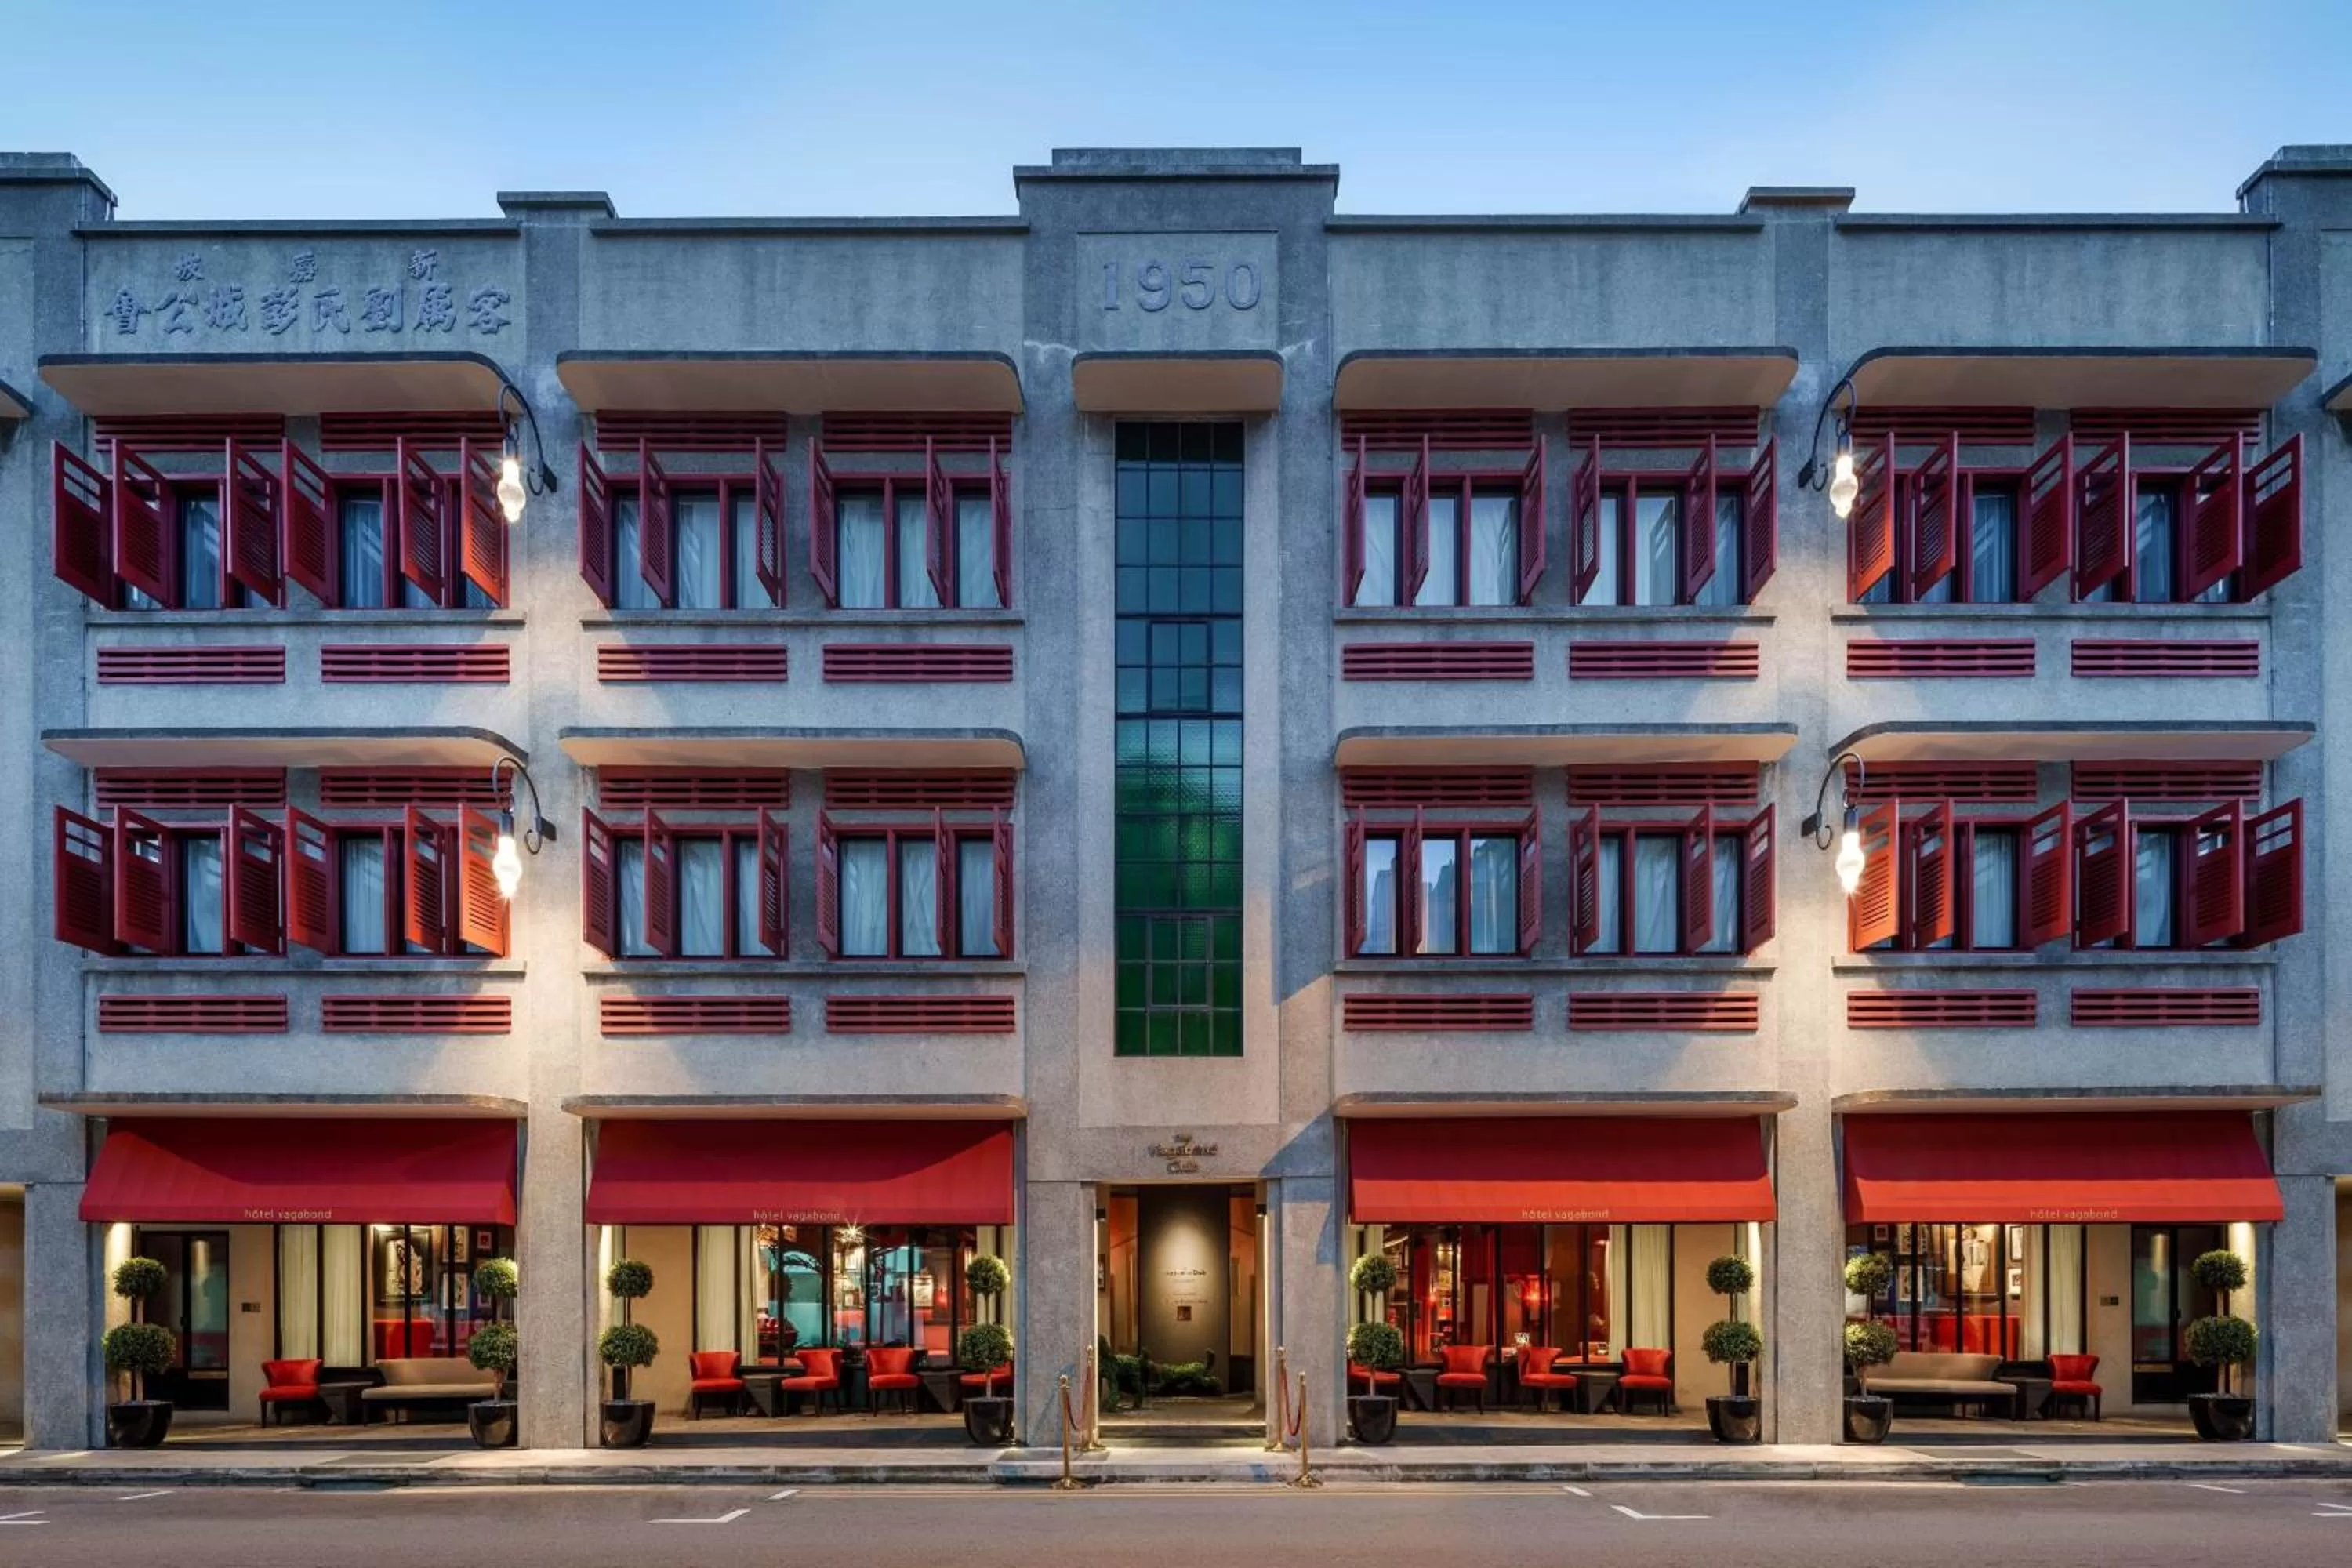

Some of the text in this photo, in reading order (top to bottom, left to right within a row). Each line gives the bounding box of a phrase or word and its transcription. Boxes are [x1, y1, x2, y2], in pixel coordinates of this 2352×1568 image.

[1103, 259, 1261, 312] 1950
[278, 1208, 332, 1221] vagabond
[787, 1208, 841, 1221] vagabond
[1555, 1208, 1610, 1221] vagabond
[2063, 1208, 2118, 1221] vagabond
